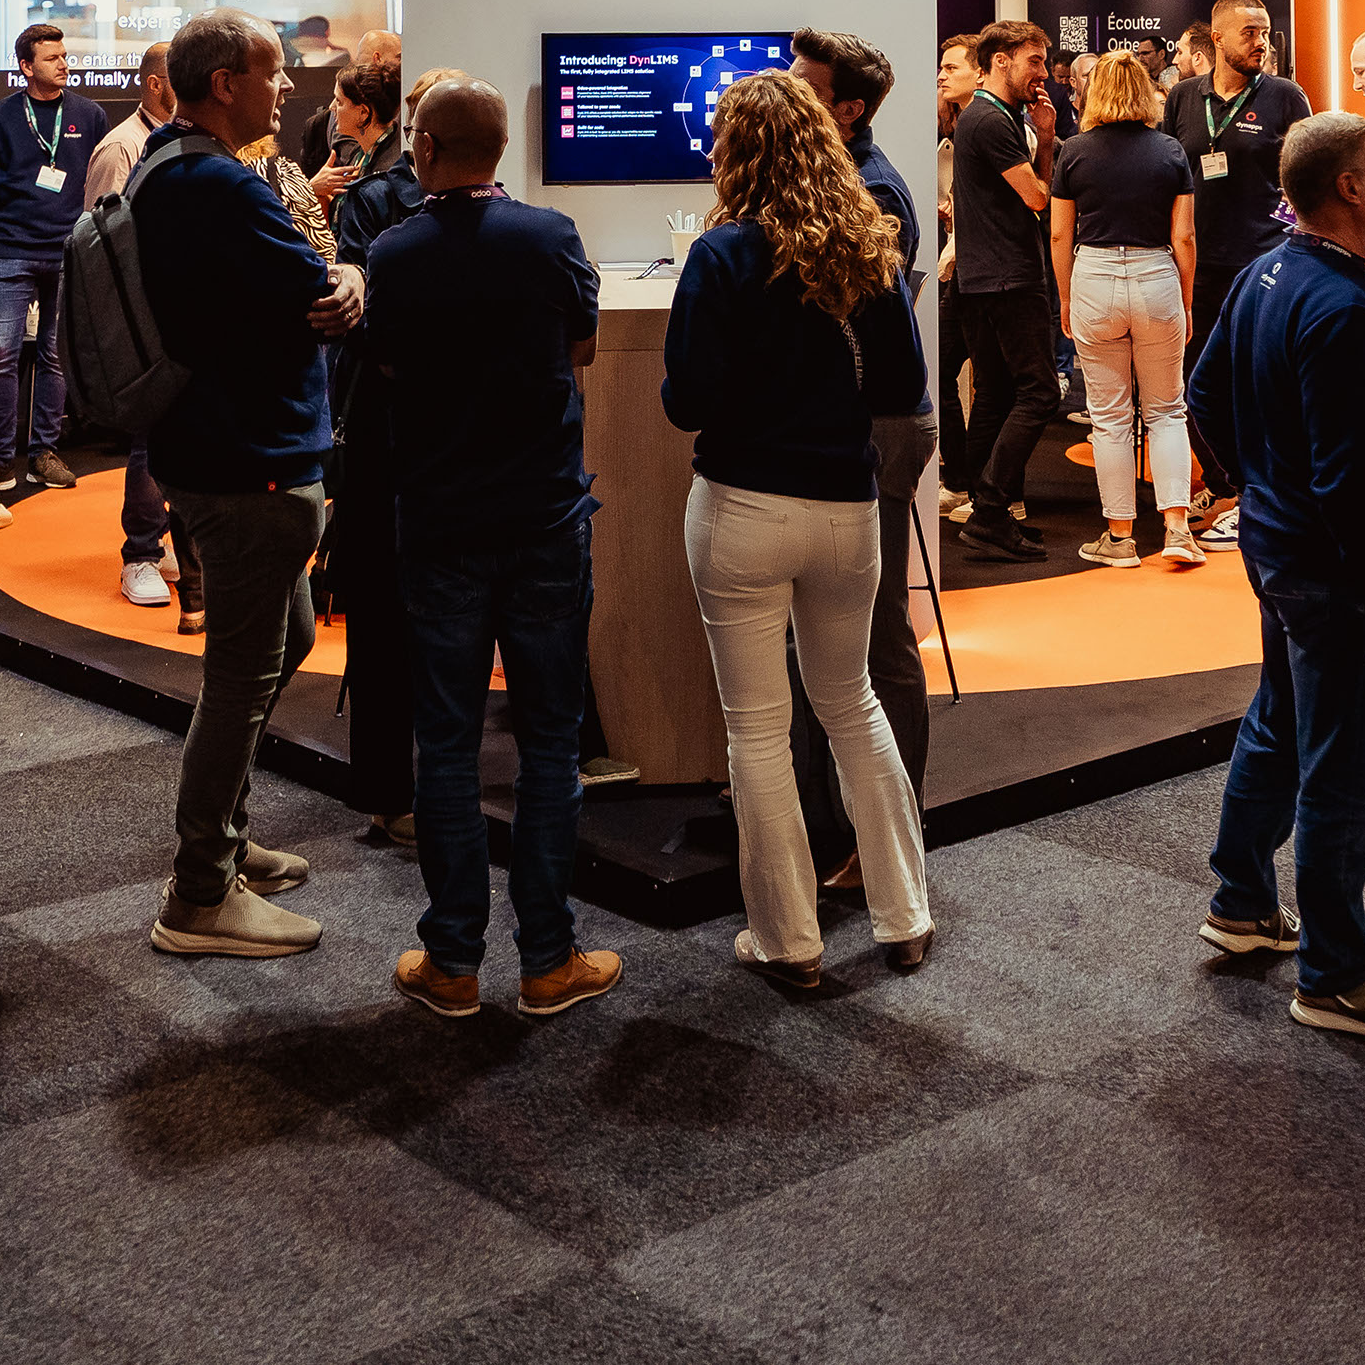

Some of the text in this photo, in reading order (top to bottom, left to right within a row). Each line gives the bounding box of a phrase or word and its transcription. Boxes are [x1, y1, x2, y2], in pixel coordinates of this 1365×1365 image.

[1107, 11, 1161, 31] Écoutez
[84, 55, 124, 68] enter
[559, 54, 679, 67] Introducing: DynLIMS
[84, 70, 130, 90] finally
[1236, 121, 1263, 131] dynapps
[471, 188, 492, 198] odoo
